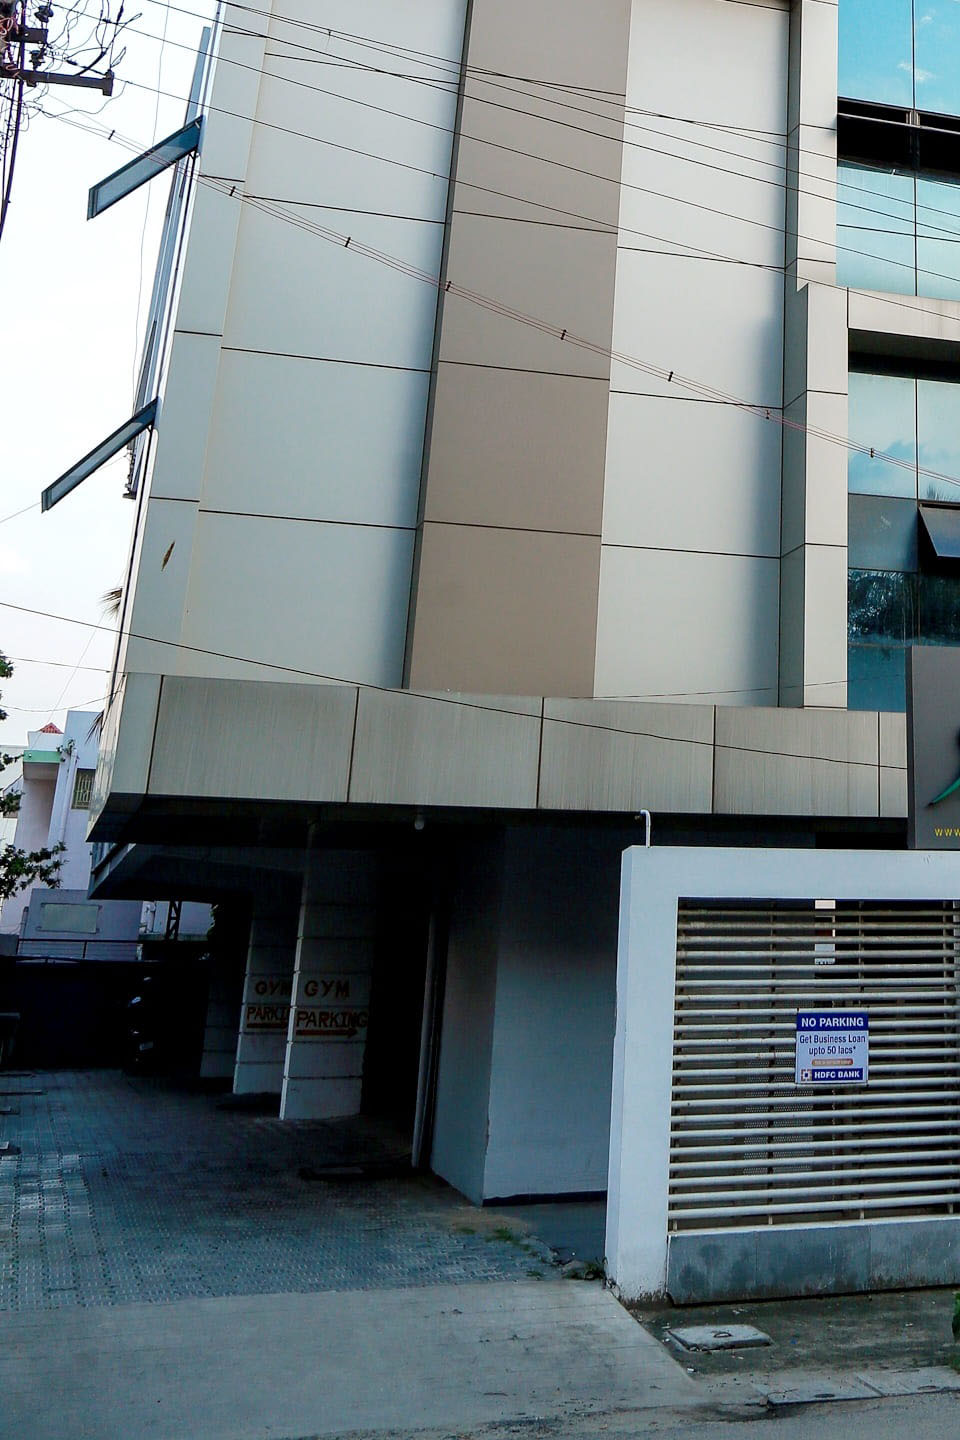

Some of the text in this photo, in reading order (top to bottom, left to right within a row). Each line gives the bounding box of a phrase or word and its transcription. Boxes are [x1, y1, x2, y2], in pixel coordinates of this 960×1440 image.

[304, 980, 350, 998] GYM
[296, 1010, 369, 1028] PARKING
[801, 1017, 864, 1028] NO PARKING
[799, 1033, 866, 1044] Get Business Loan
[808, 1046, 825, 1056] upto
[827, 1046, 836, 1055] 50
[814, 1070, 860, 1079] HDFC BANK
